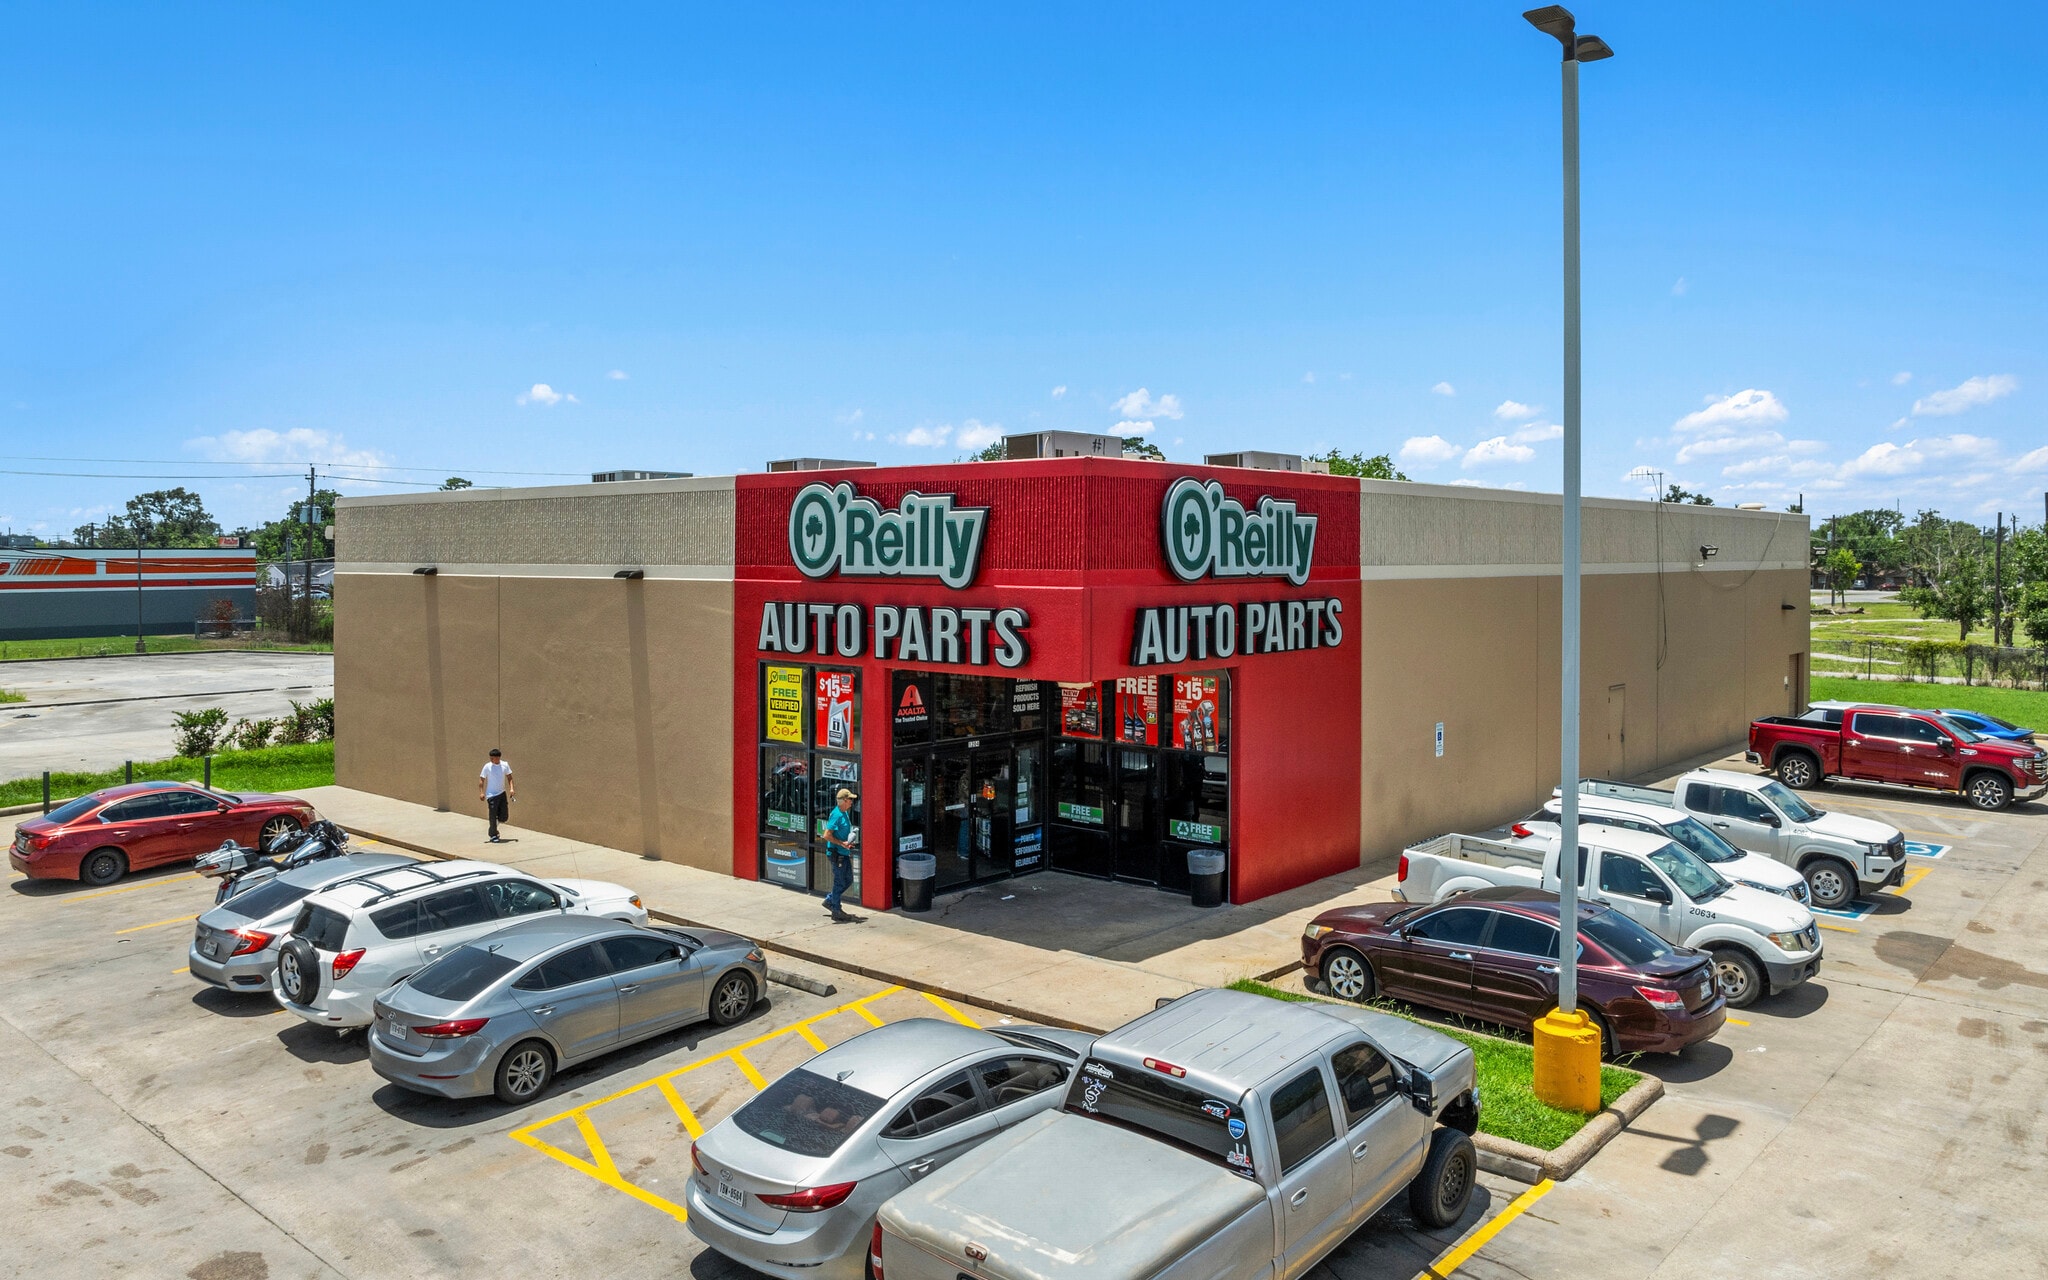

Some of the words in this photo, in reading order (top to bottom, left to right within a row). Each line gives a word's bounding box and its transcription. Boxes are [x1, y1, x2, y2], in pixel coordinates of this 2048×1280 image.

[793, 492, 976, 578] O'Reilly
[1172, 489, 1314, 577] O'Reilly
[759, 602, 866, 657] AUTO
[874, 605, 1030, 667] PARTS
[1134, 604, 1235, 665] AUTO
[1242, 598, 1343, 654] PARTS
[772, 687, 797, 698] FREE
[819, 676, 840, 698] $15
[1015, 683, 1038, 693] REFINISH
[1063, 689, 1079, 697] NEW
[1116, 677, 1158, 696] FREE
[1177, 680, 1202, 700] $15
[1013, 692, 1040, 703] PRODUCTS
[770, 699, 799, 712] VERIFIED
[897, 707, 926, 716] AXALTA
[1012, 703, 1026, 713] SOLD
[1026, 702, 1040, 711] HERE
[1071, 804, 1091, 816] FREE
[790, 814, 804, 823] FREE
[1190, 822, 1212, 836] FREE
[1020, 833, 1035, 843] POWER
[1689, 906, 1717, 920] 20634
